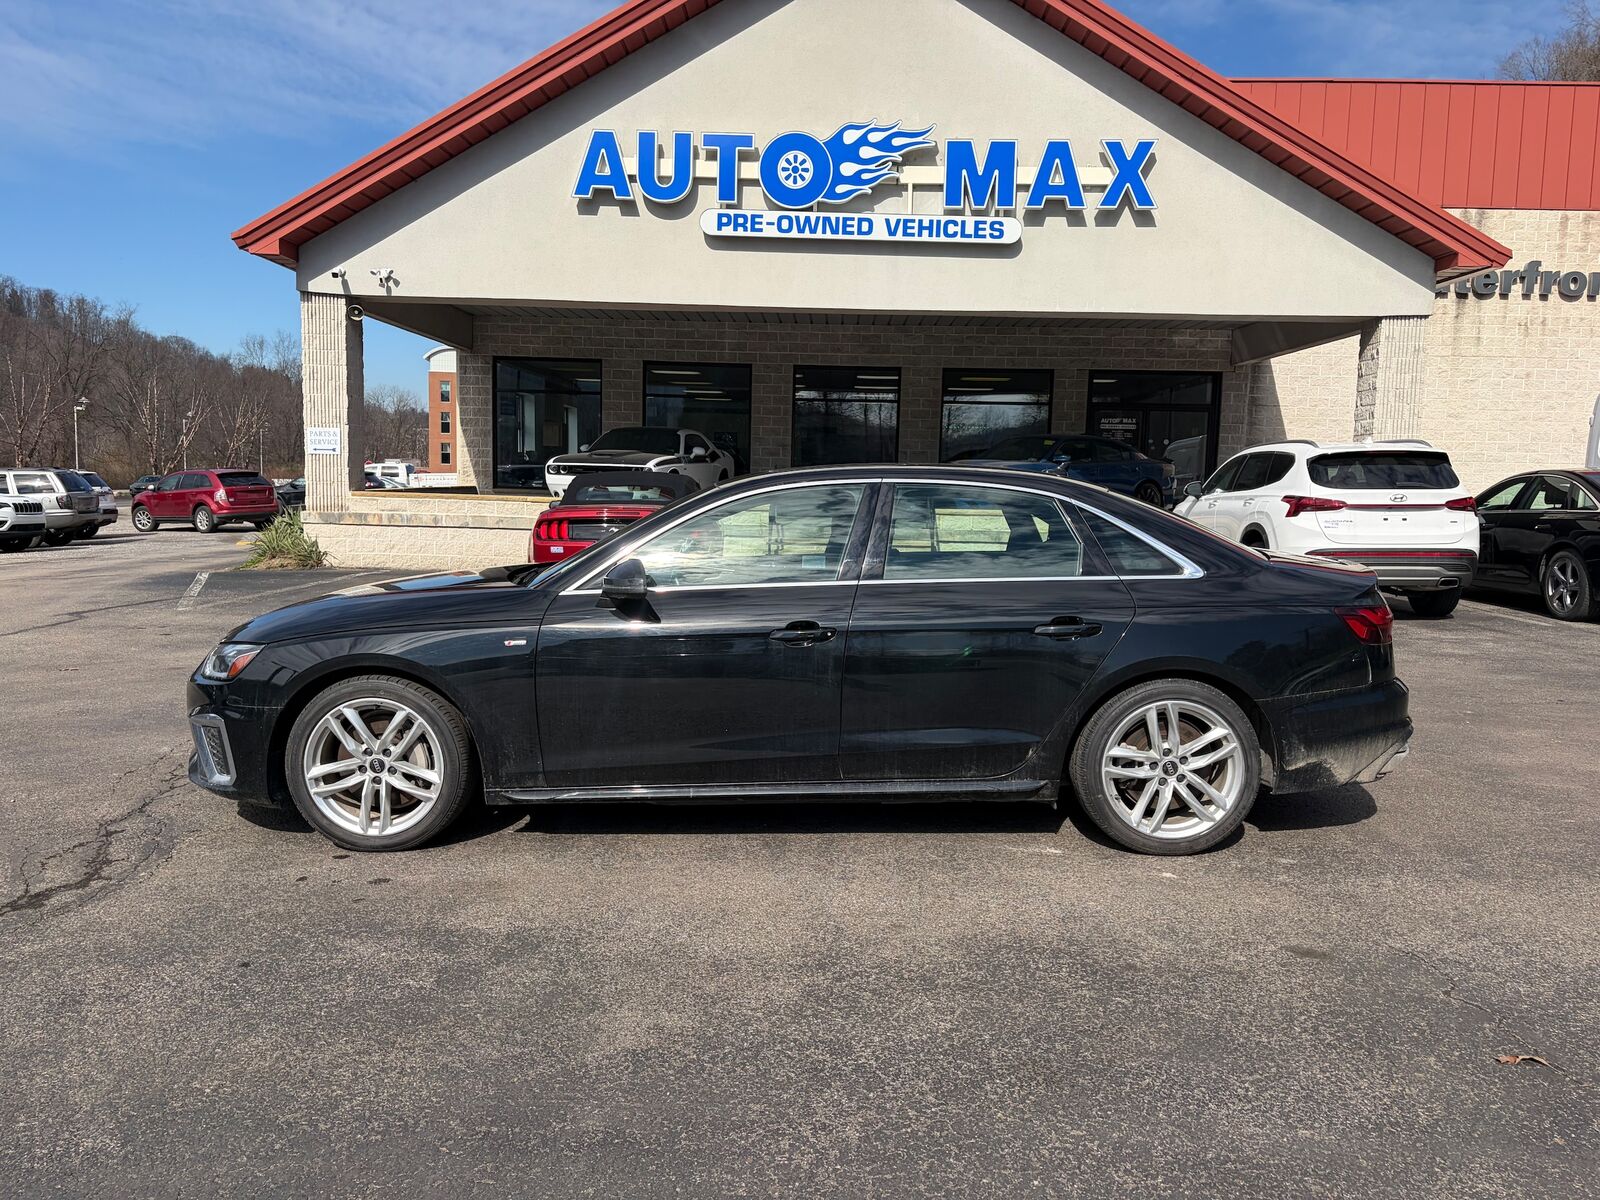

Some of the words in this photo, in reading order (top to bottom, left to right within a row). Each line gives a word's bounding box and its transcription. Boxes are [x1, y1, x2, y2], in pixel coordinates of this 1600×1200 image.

[572, 129, 833, 209] AUTO
[943, 138, 1158, 211] MAX
[716, 212, 874, 237] PRE-OWNED
[884, 217, 1005, 240] VEHICLES
